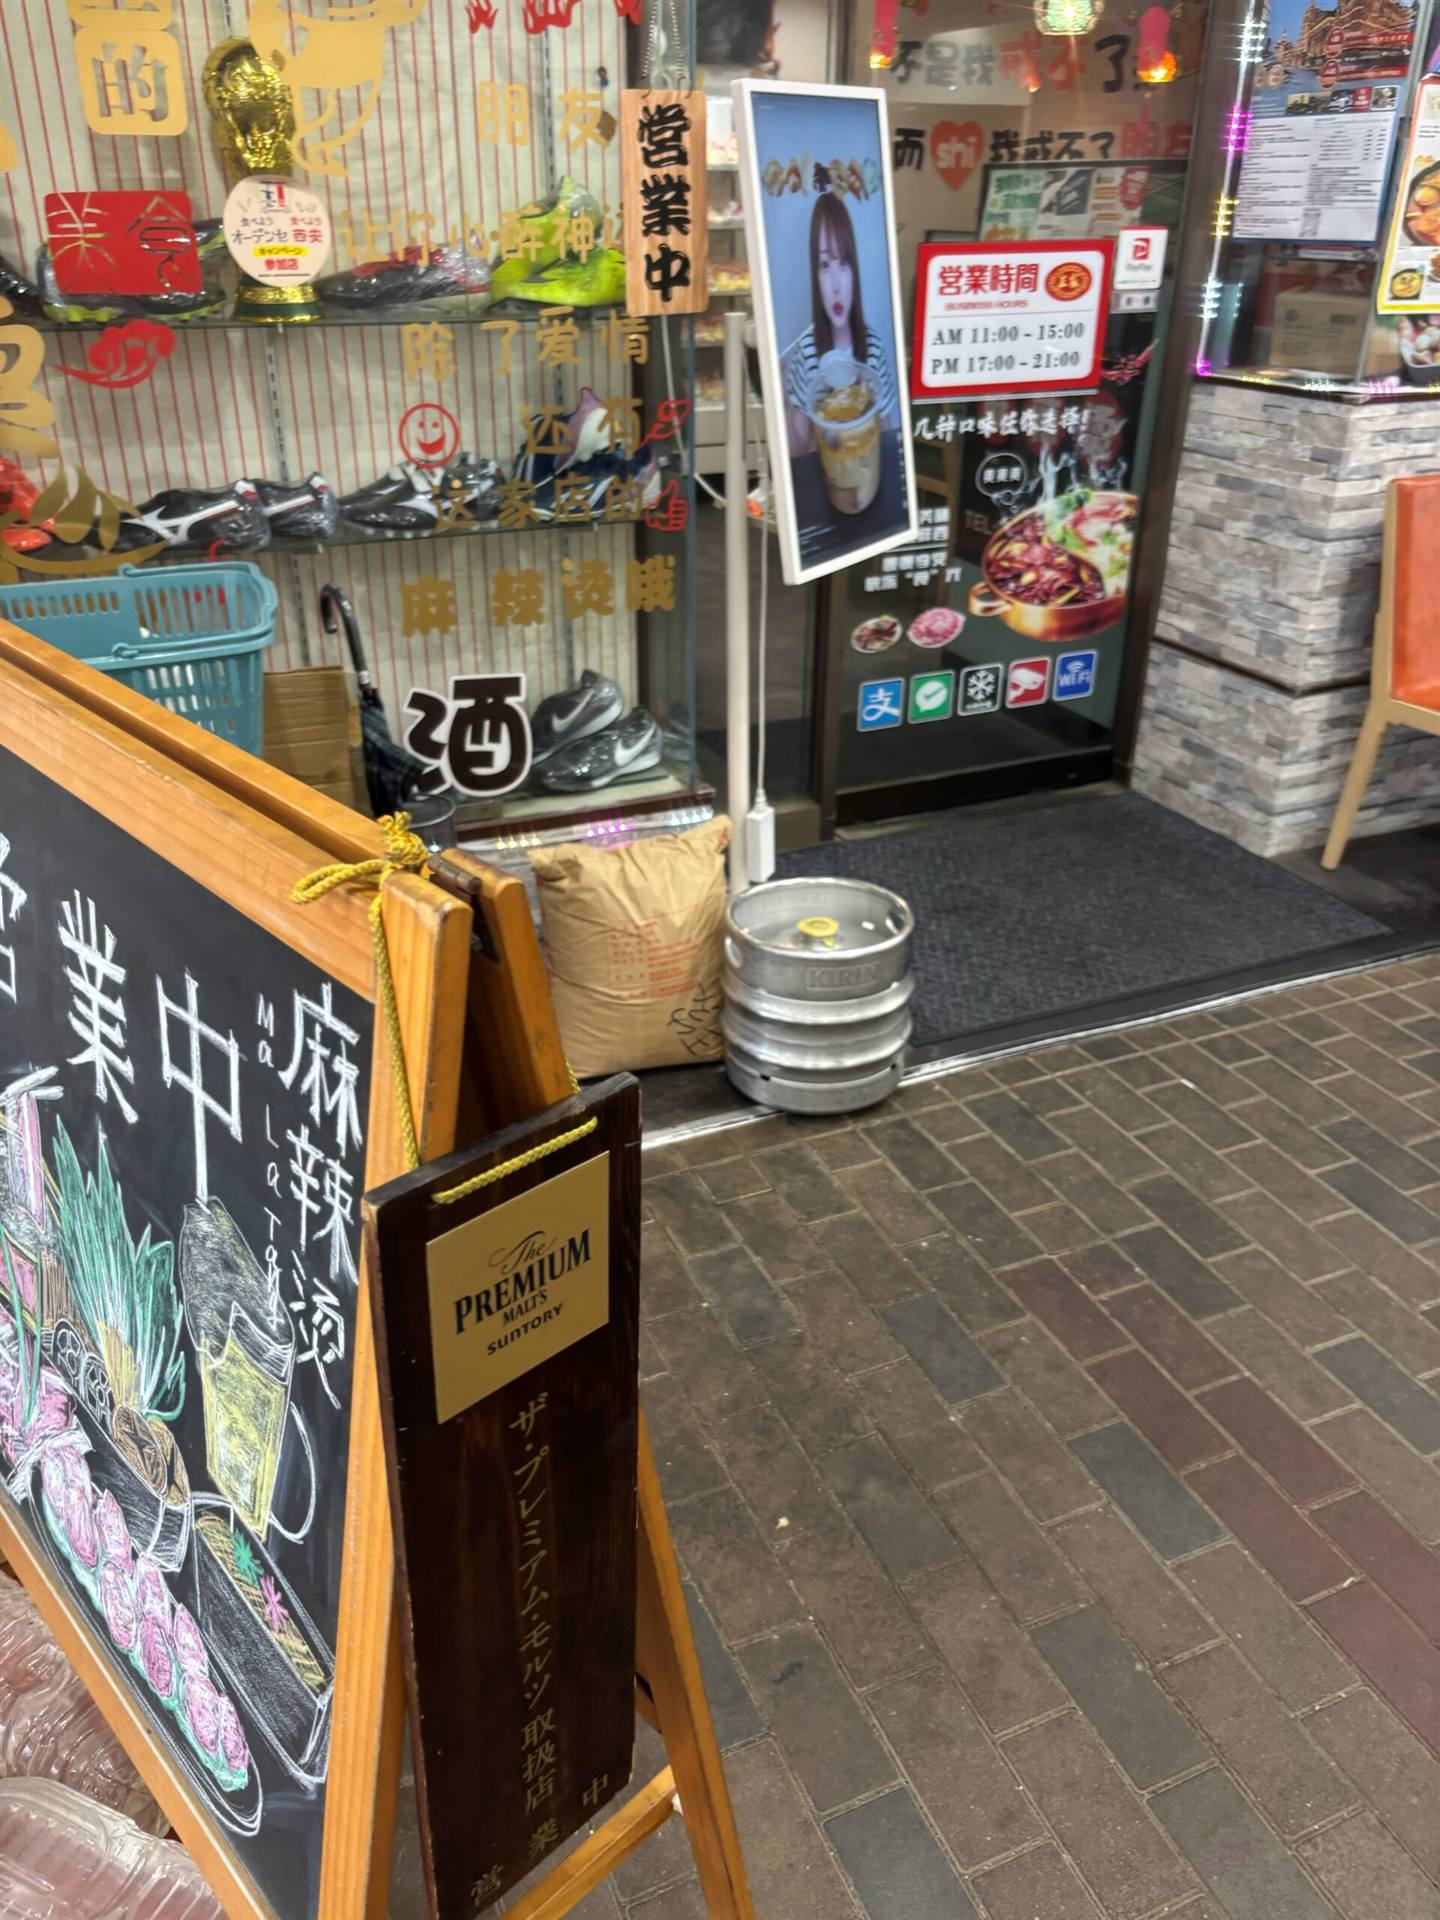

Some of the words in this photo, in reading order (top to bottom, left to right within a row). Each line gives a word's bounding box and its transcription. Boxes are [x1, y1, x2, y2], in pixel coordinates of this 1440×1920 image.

[478, 80, 618, 148] 朋友
[637, 103, 692, 302] 営業中
[938, 264, 1039, 296] 営業時間
[401, 305, 650, 382] 除了爱情
[930, 359, 960, 374] PM
[967, 355, 1015, 372] 17:00
[1032, 351, 1080, 368] 21:00
[932, 329, 963, 345] AM
[971, 326, 1019, 343] 11:00
[1038, 322, 1085, 340] 15:00
[519, 398, 643, 459] 还有
[433, 472, 645, 534] 这家店的
[403, 675, 530, 795] 酒
[454, 1228, 591, 1336] PREMIUM
[488, 1230, 557, 1275] The
[470, 1774, 608, 1907] 営業中
